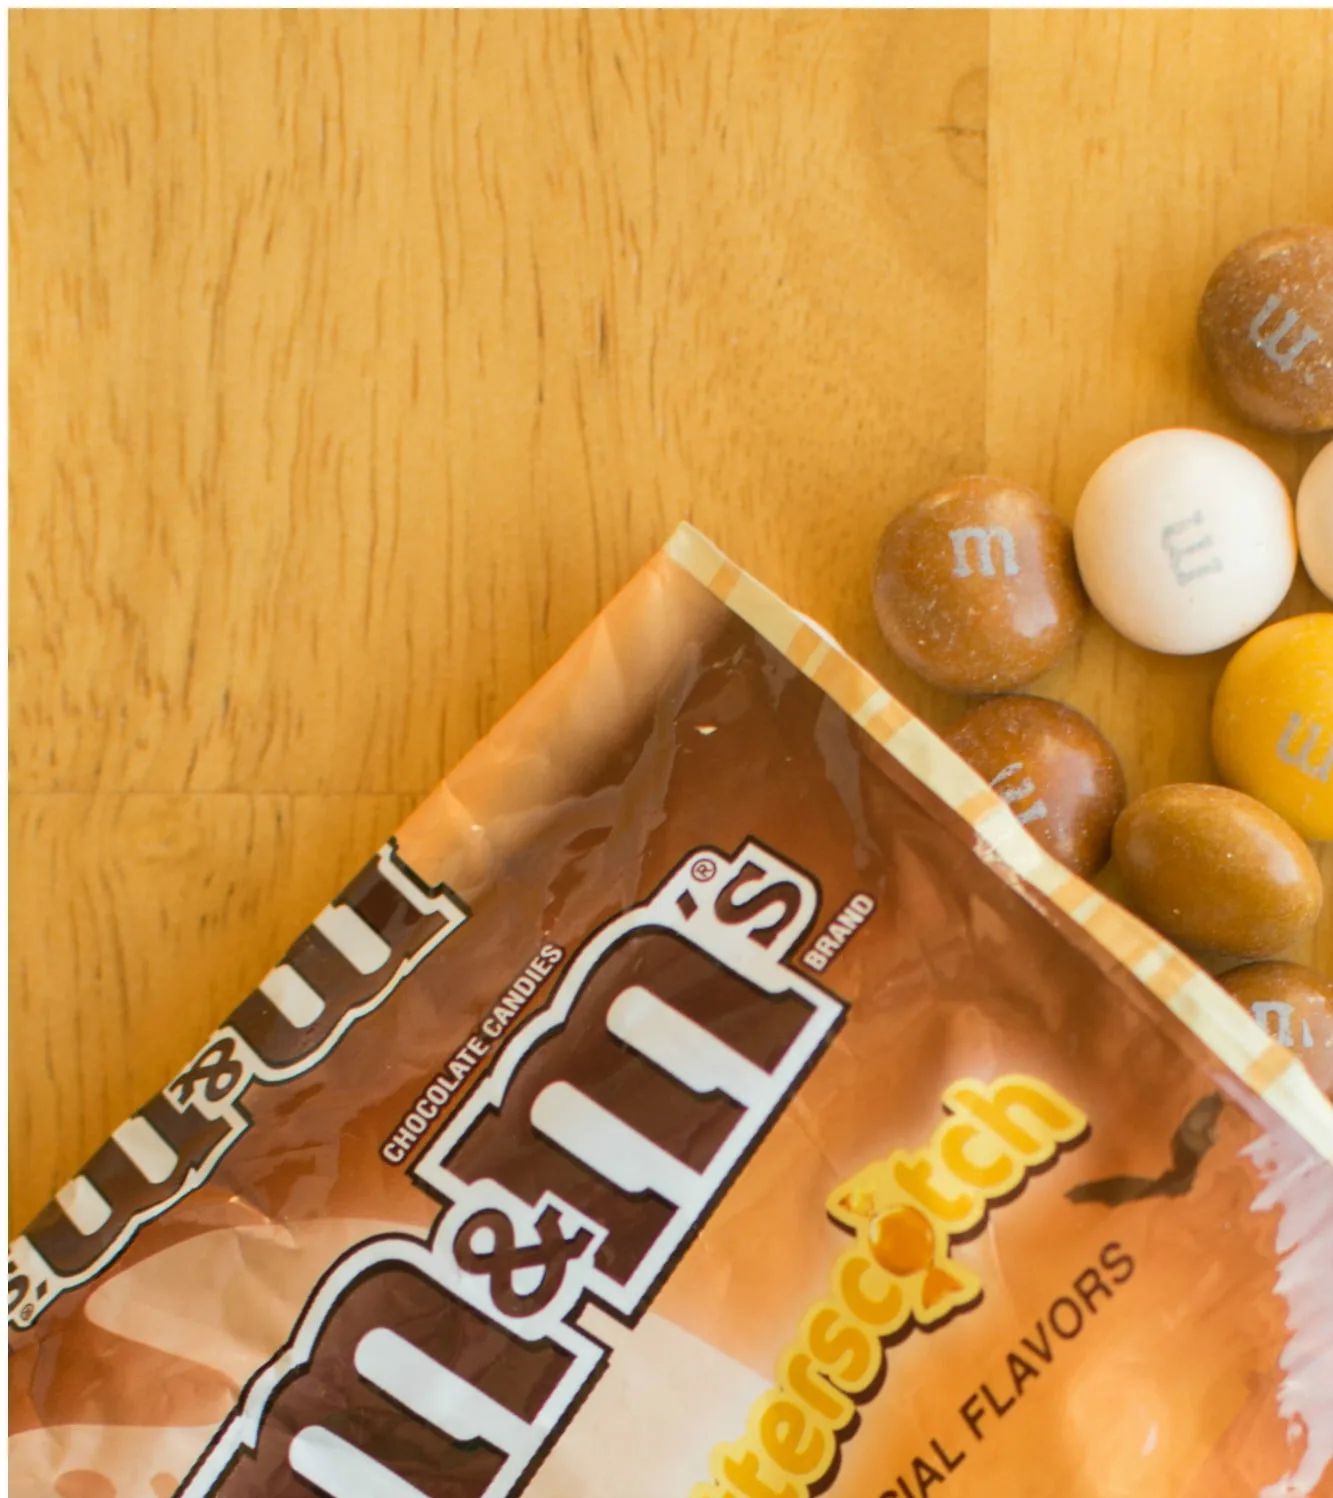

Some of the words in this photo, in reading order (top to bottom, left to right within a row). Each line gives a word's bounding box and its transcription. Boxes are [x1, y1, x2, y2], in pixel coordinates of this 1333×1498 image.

[1250, 293, 1317, 367] m
[950, 522, 1018, 576] m
[1161, 512, 1224, 586] m
[803, 894, 875, 971] BRAND
[382, 1035, 490, 1164] CHOCOLATE
[482, 944, 563, 1039] CANDIES
[959, 1242, 1136, 1439] FLAVORS
